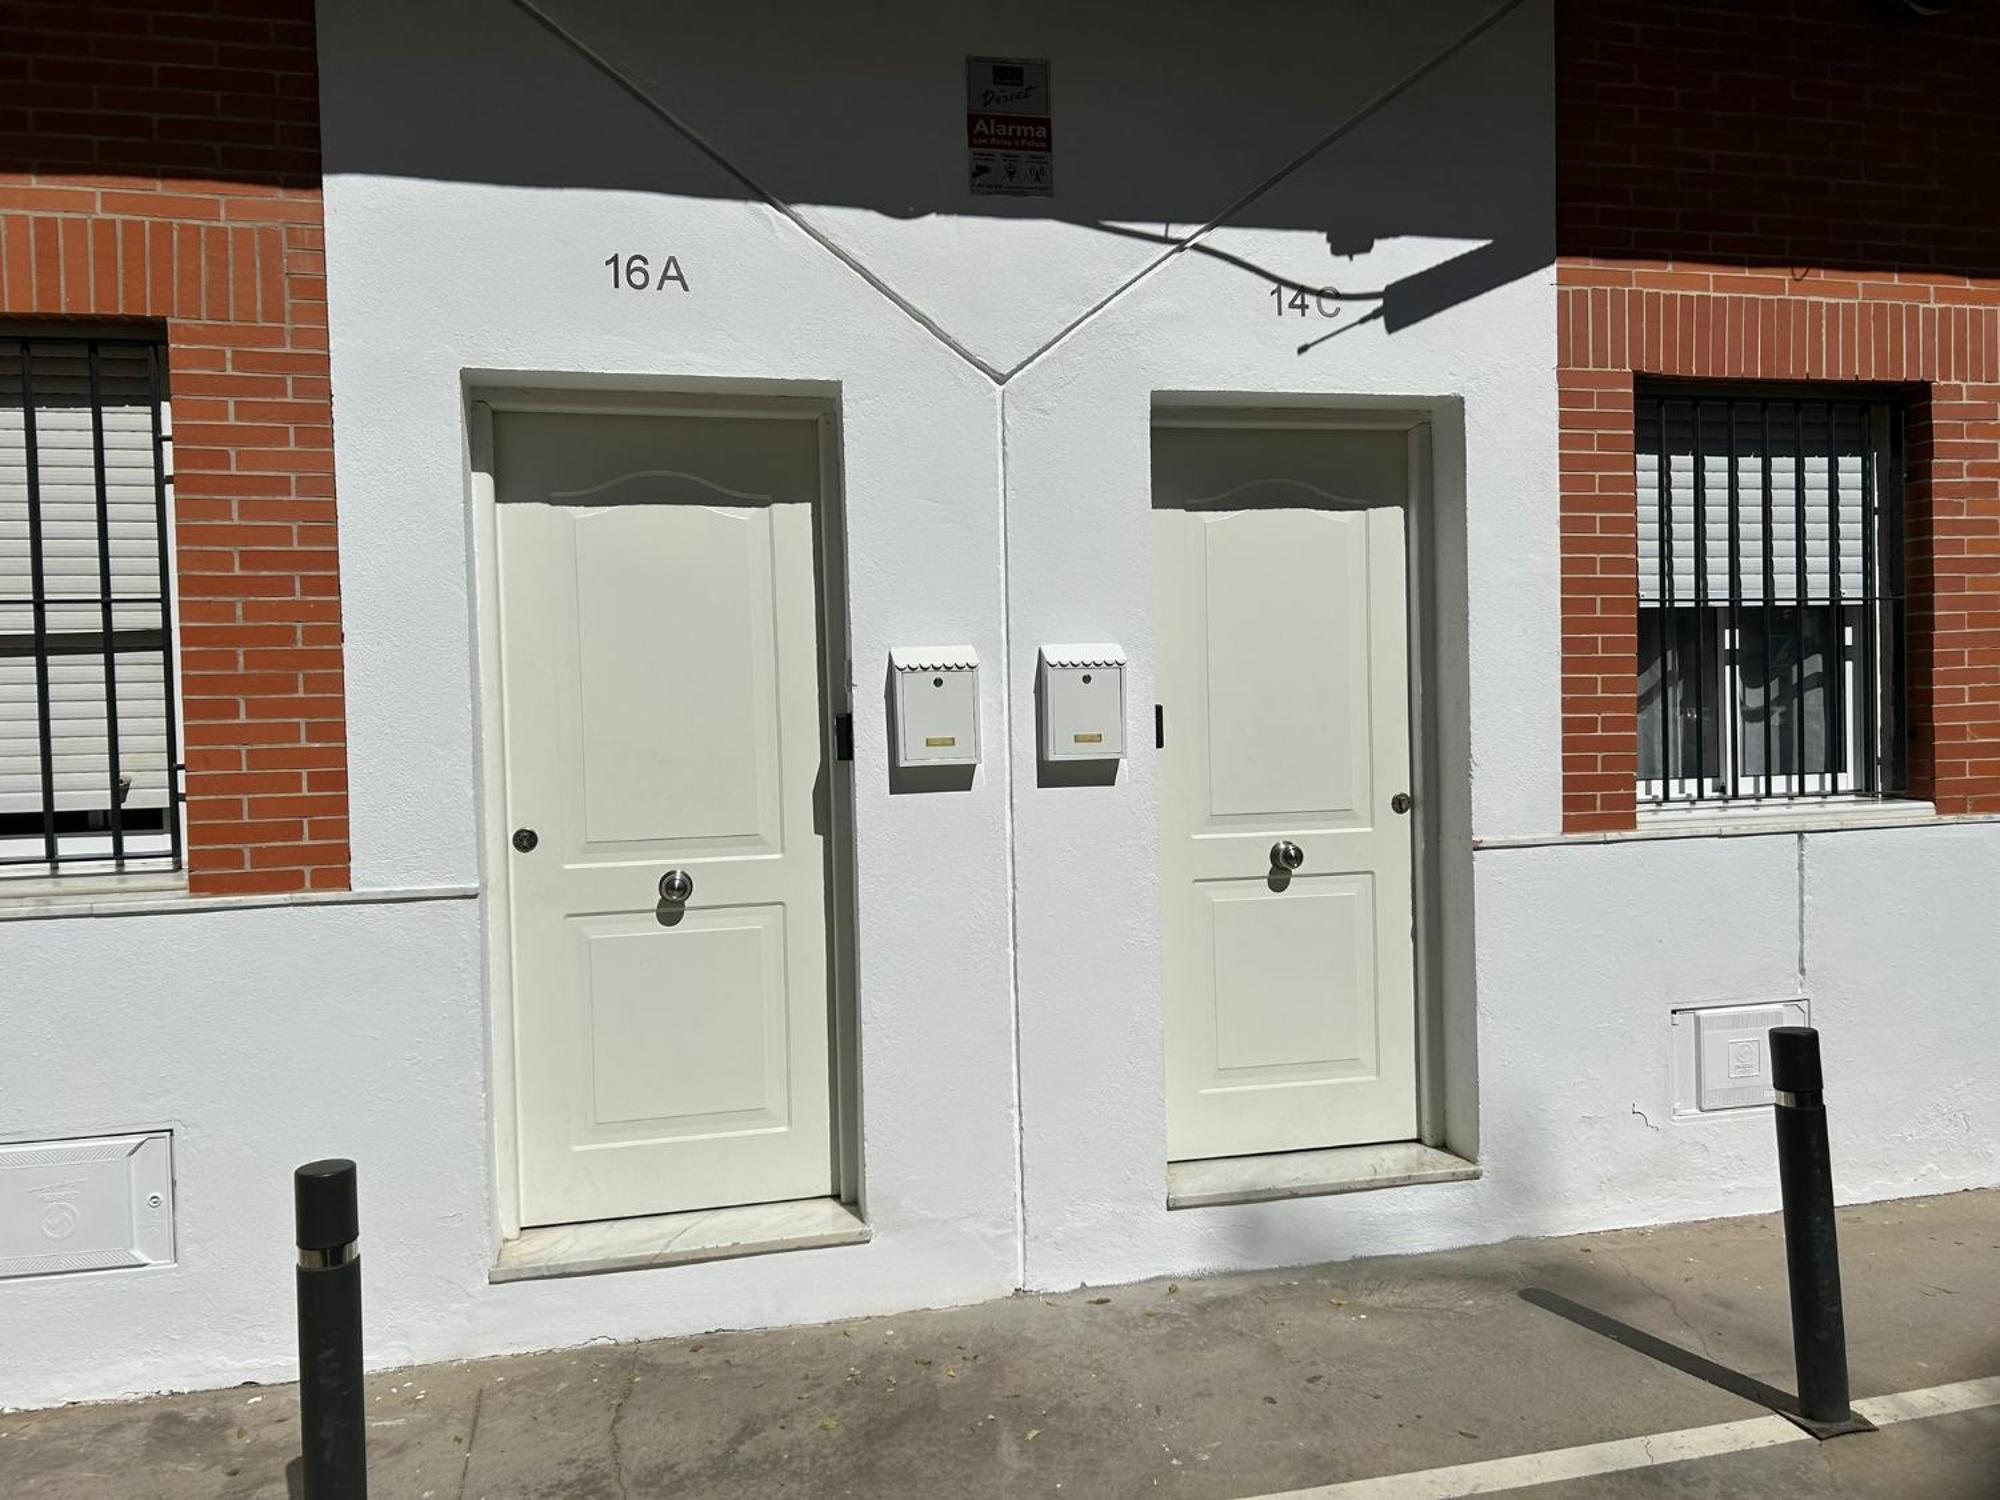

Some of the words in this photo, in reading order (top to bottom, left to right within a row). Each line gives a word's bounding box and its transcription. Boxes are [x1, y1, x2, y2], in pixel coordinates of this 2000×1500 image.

[974, 118, 1047, 138] Alarma
[605, 253, 690, 292] 16A
[1270, 283, 1341, 318] 14C
